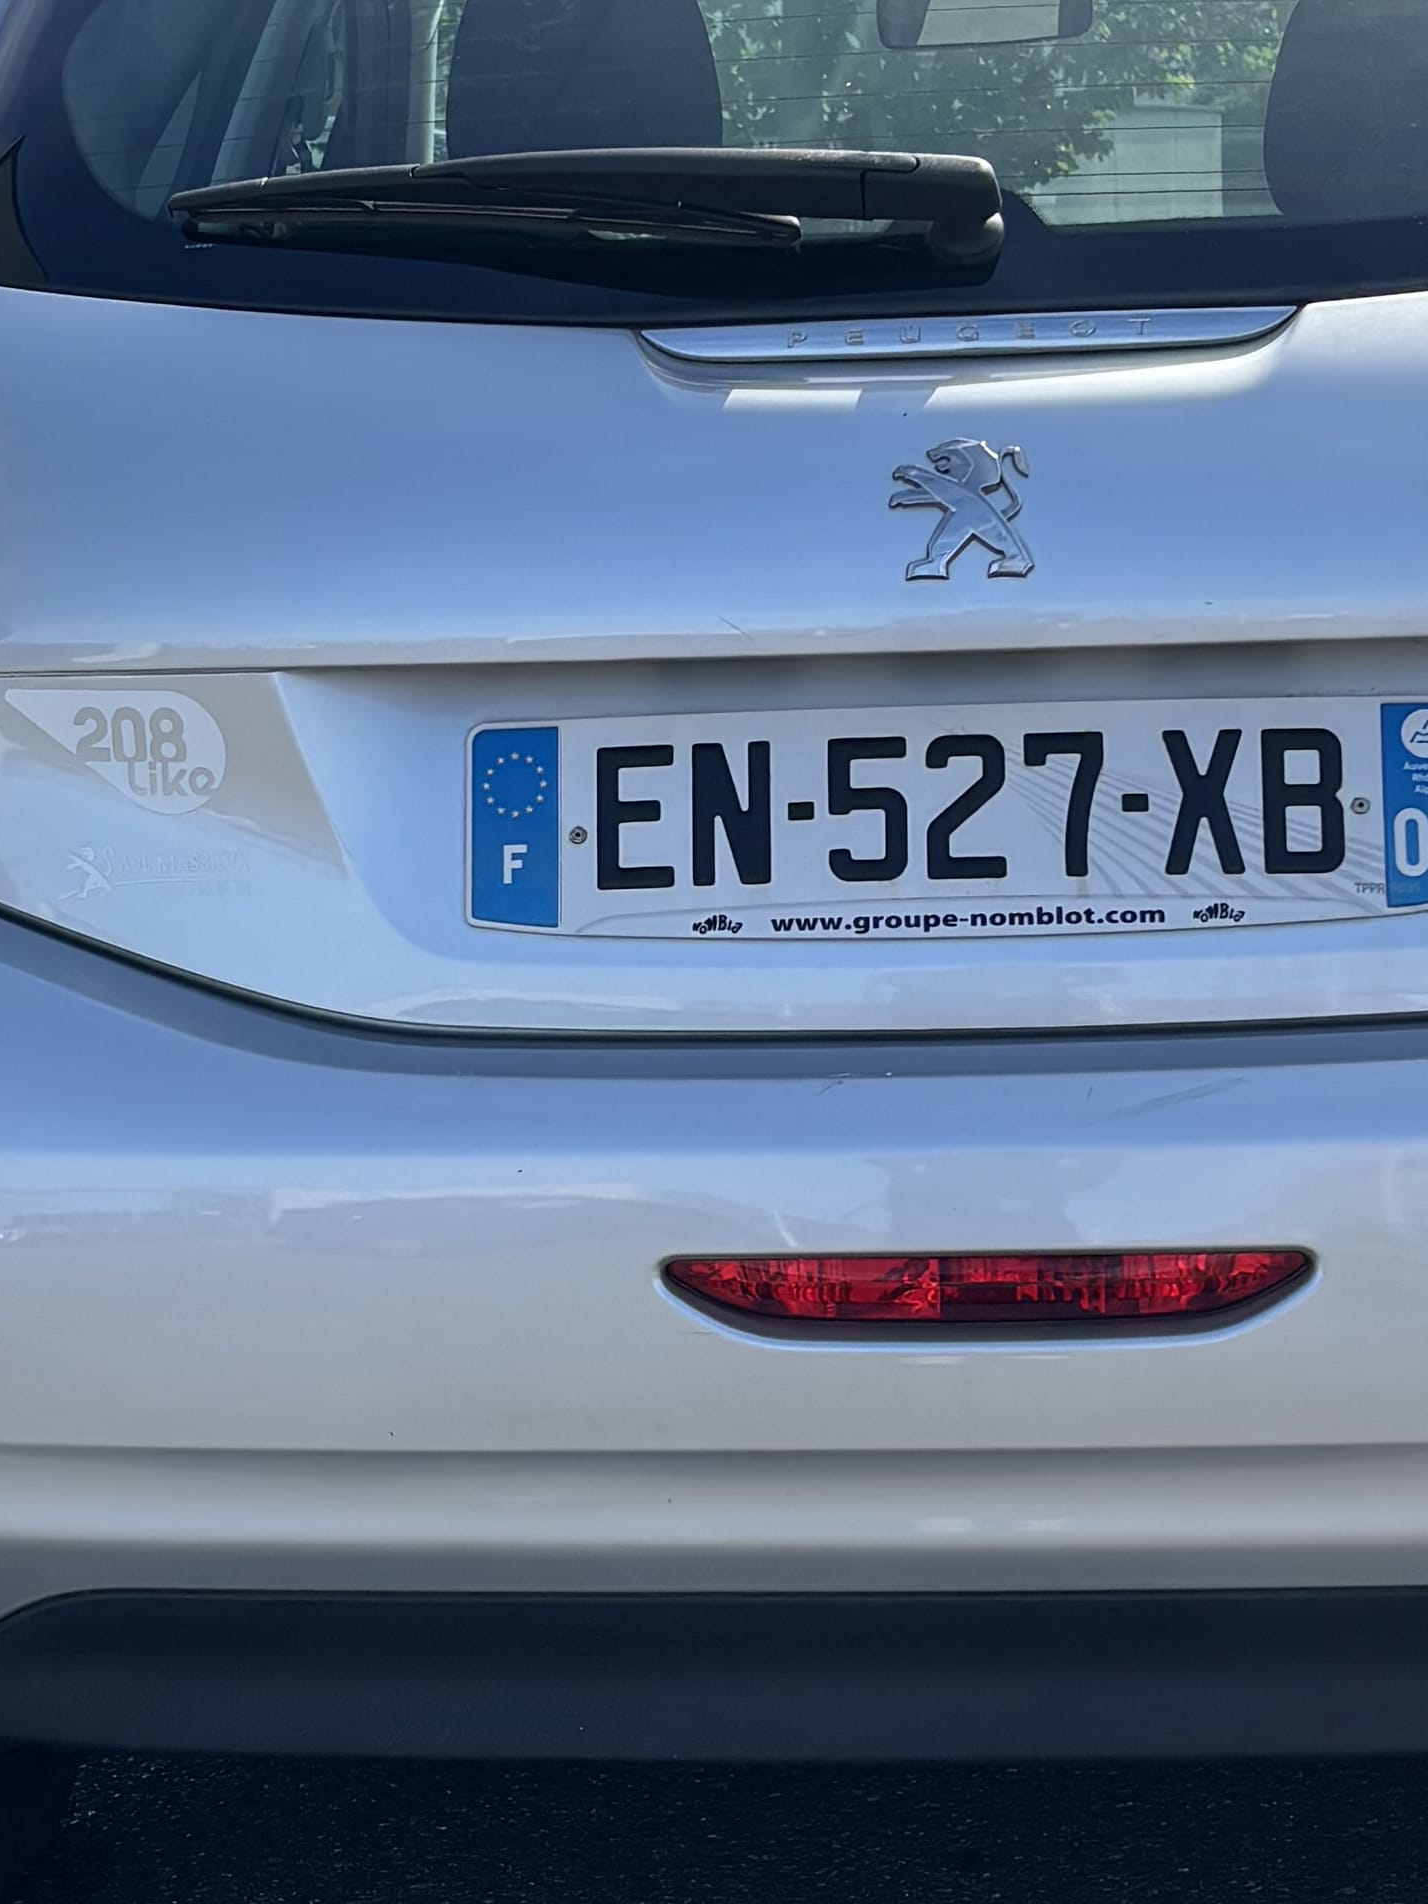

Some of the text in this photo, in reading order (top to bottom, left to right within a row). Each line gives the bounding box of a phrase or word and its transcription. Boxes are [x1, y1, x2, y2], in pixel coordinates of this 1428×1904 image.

[786, 317, 1152, 349] PEUGEOT
[73, 706, 187, 762] 208
[127, 761, 222, 797] like
[595, 727, 1346, 891] EN-527-XB
[502, 844, 528, 885] F
[770, 906, 1166, 935] www.groupe-nomblot.com
